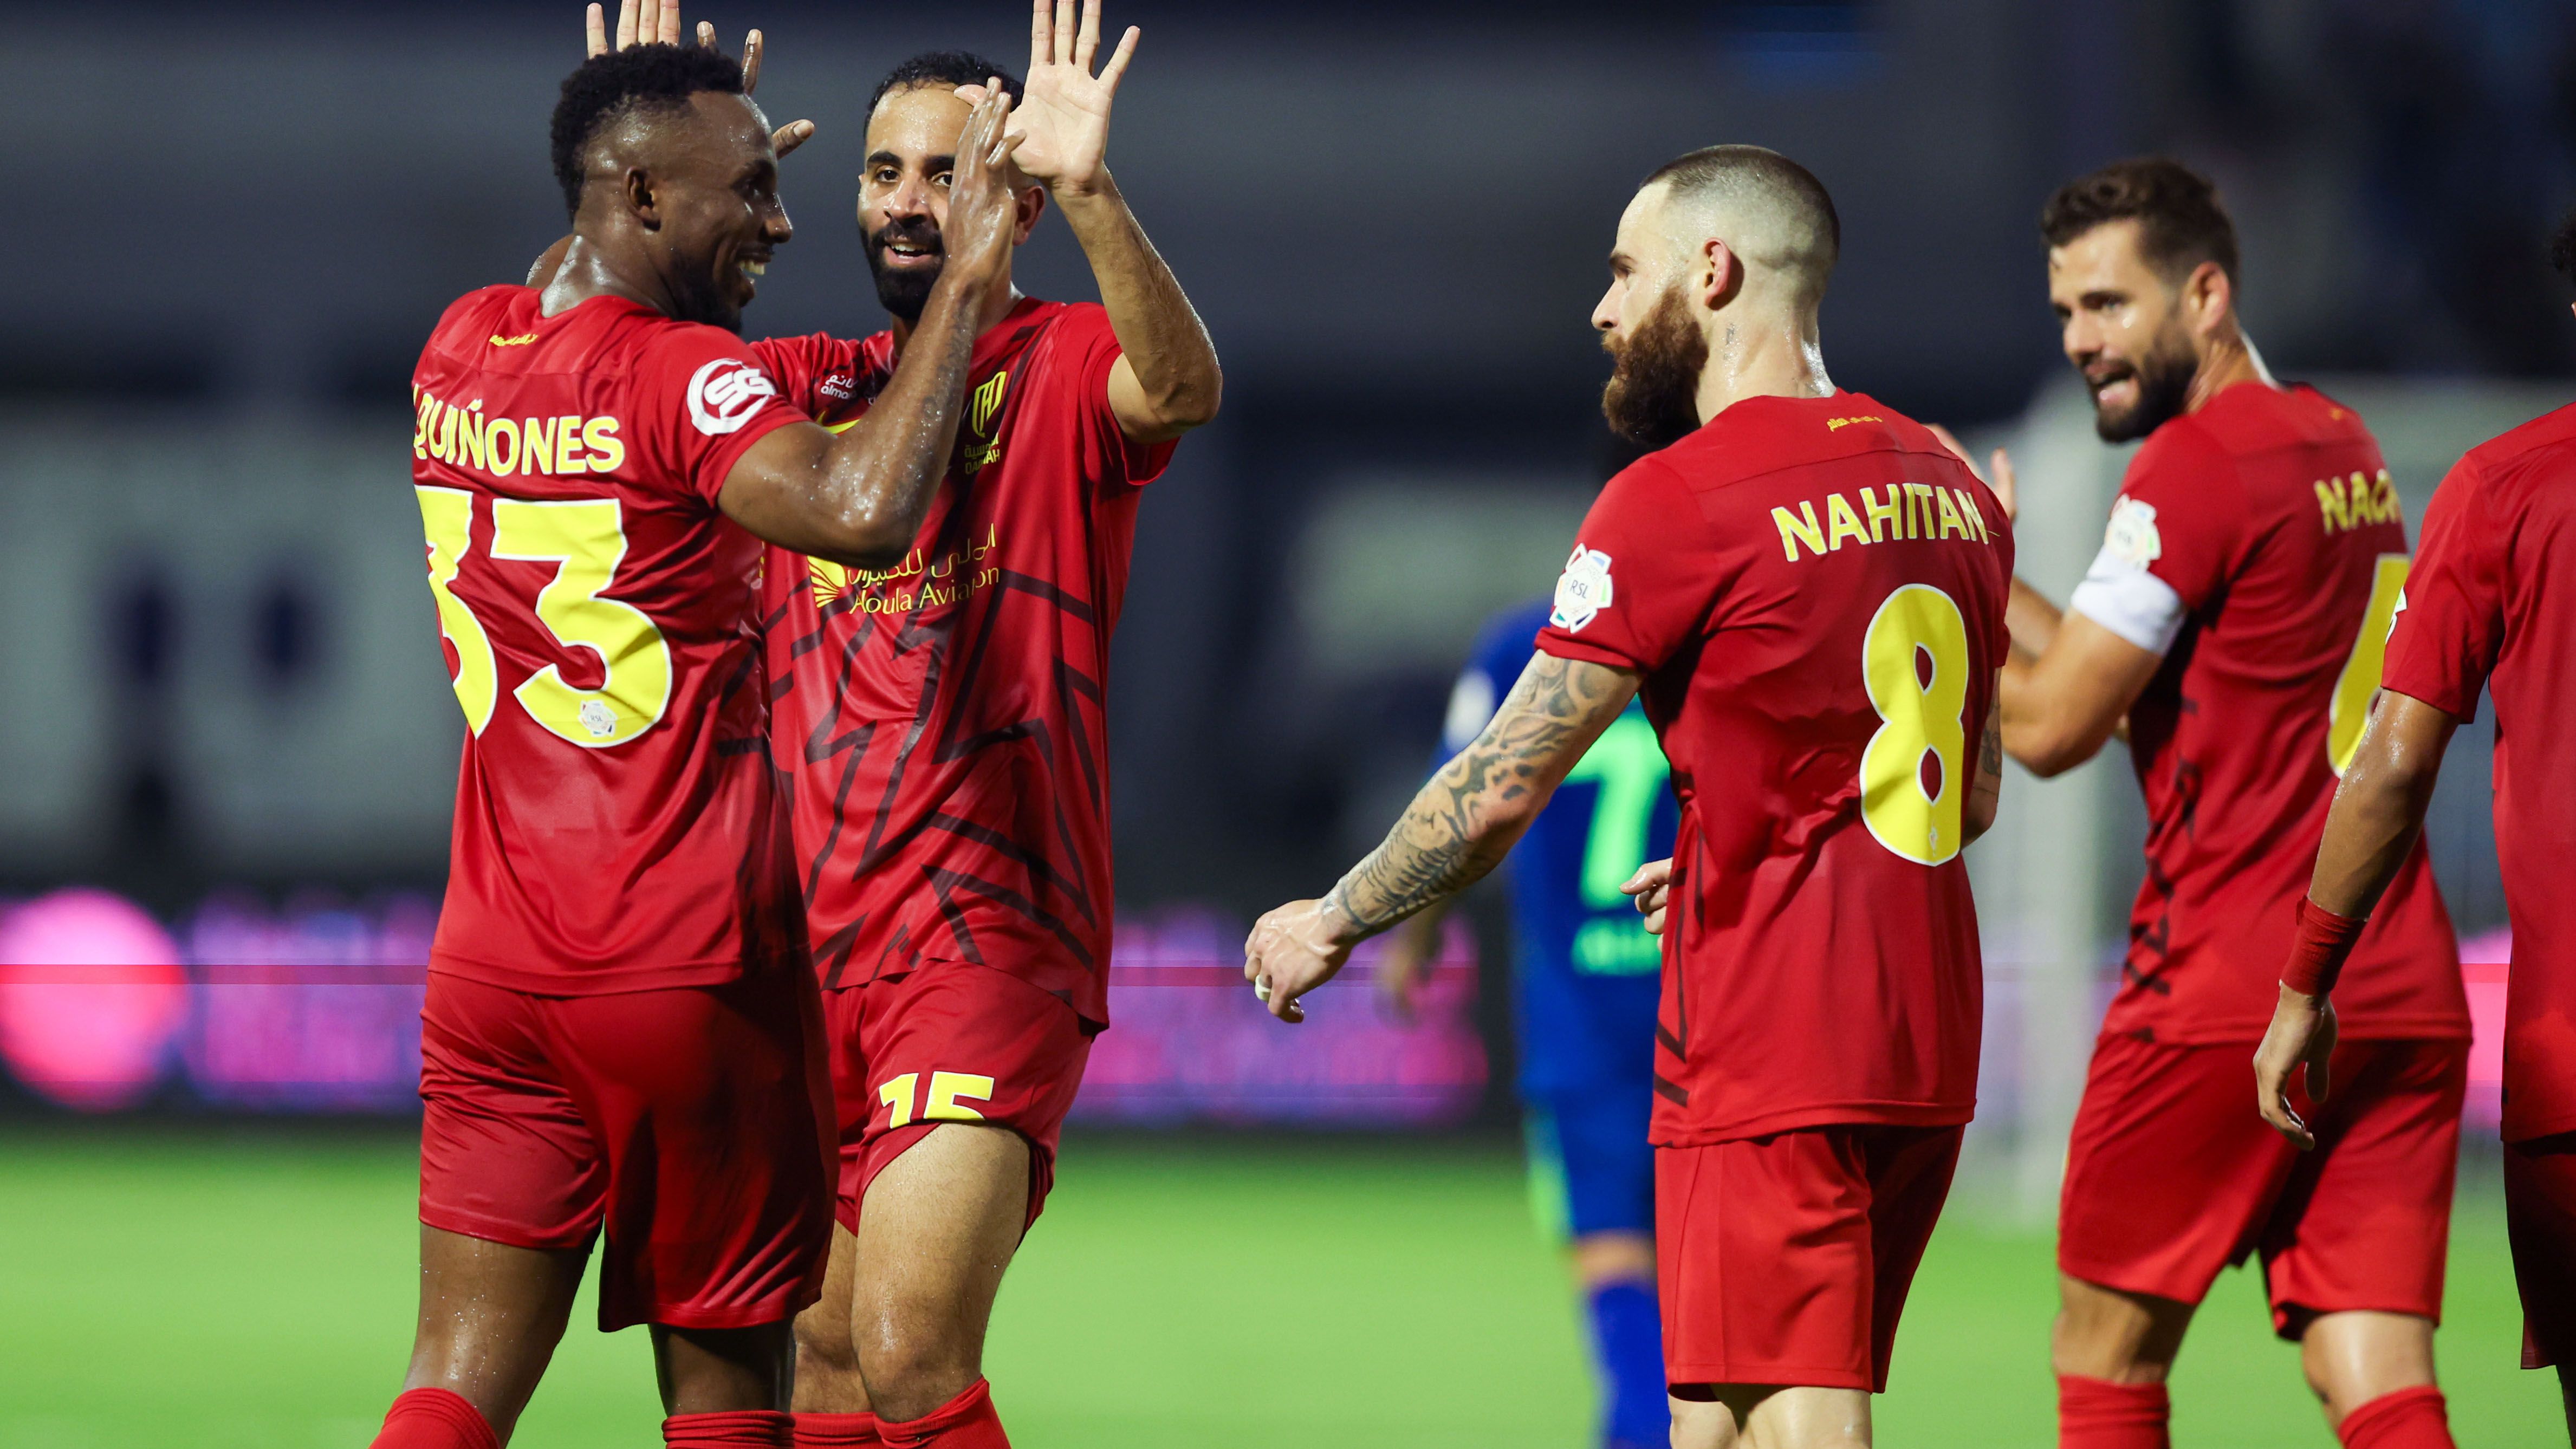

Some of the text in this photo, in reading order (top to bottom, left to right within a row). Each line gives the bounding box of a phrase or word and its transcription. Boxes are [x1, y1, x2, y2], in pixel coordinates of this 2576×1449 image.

[413, 393, 625, 477] QUIÑONES
[1771, 483, 1990, 562] NAHITAN
[413, 484, 672, 748] 33
[1570, 580, 1588, 599] RSL
[1860, 583, 1969, 867] 8
[879, 1070, 995, 1129] 15
